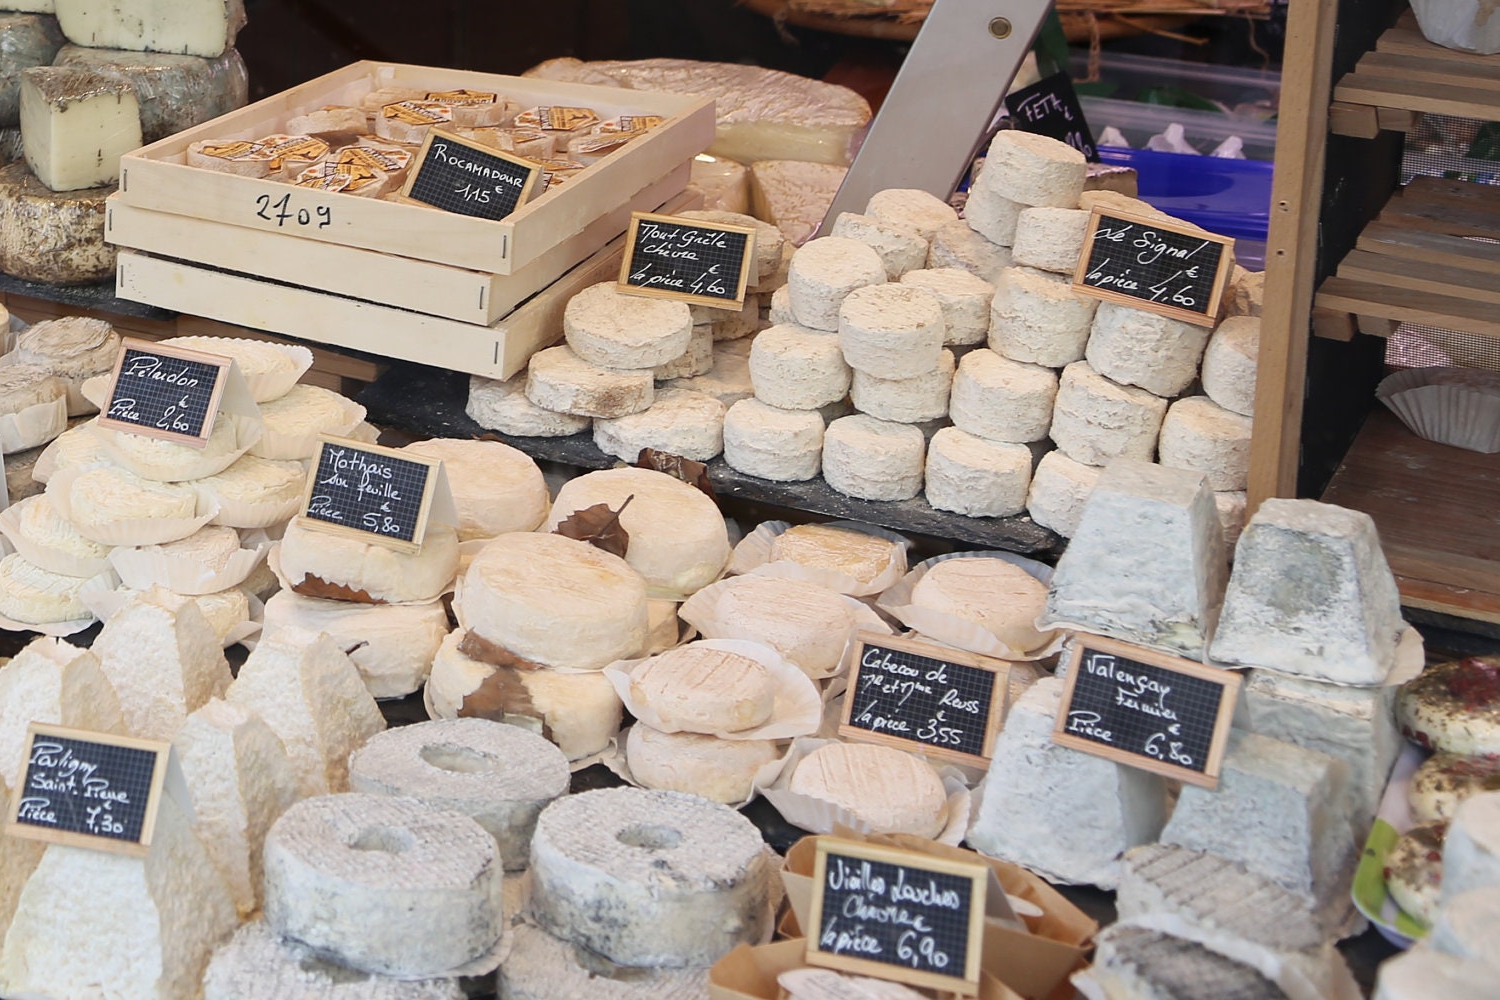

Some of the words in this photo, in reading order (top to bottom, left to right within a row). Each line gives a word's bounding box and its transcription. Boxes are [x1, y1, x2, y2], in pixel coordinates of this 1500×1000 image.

[434, 143, 523, 187] ROCAMADOUR
[1133, 231, 1210, 265] Signal
[329, 448, 393, 479] Mothais
[925, 664, 948, 684] de
[1087, 655, 1171, 709] Valençay
